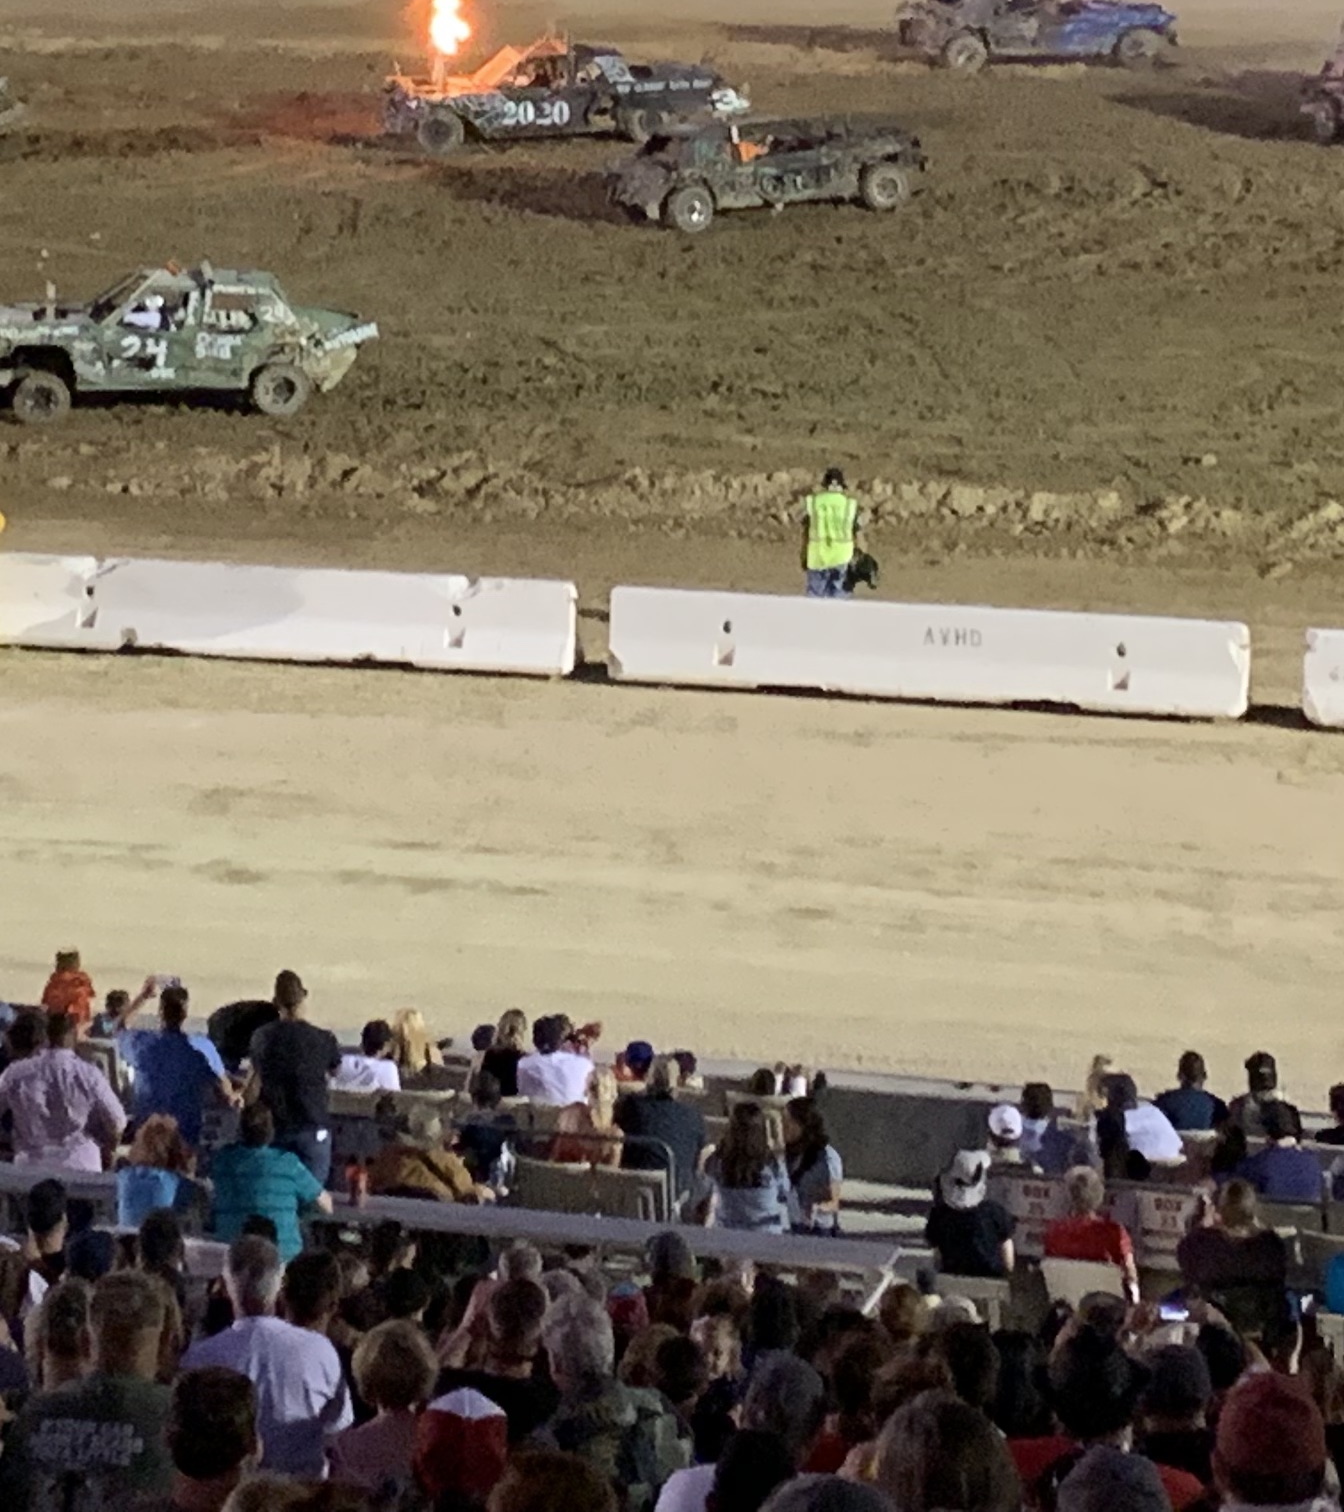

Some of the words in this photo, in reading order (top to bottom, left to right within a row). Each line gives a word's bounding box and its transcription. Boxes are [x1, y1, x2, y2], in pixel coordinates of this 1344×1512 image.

[502, 99, 571, 126] 2020
[120, 335, 169, 367] 24
[923, 626, 983, 647] AVHD
